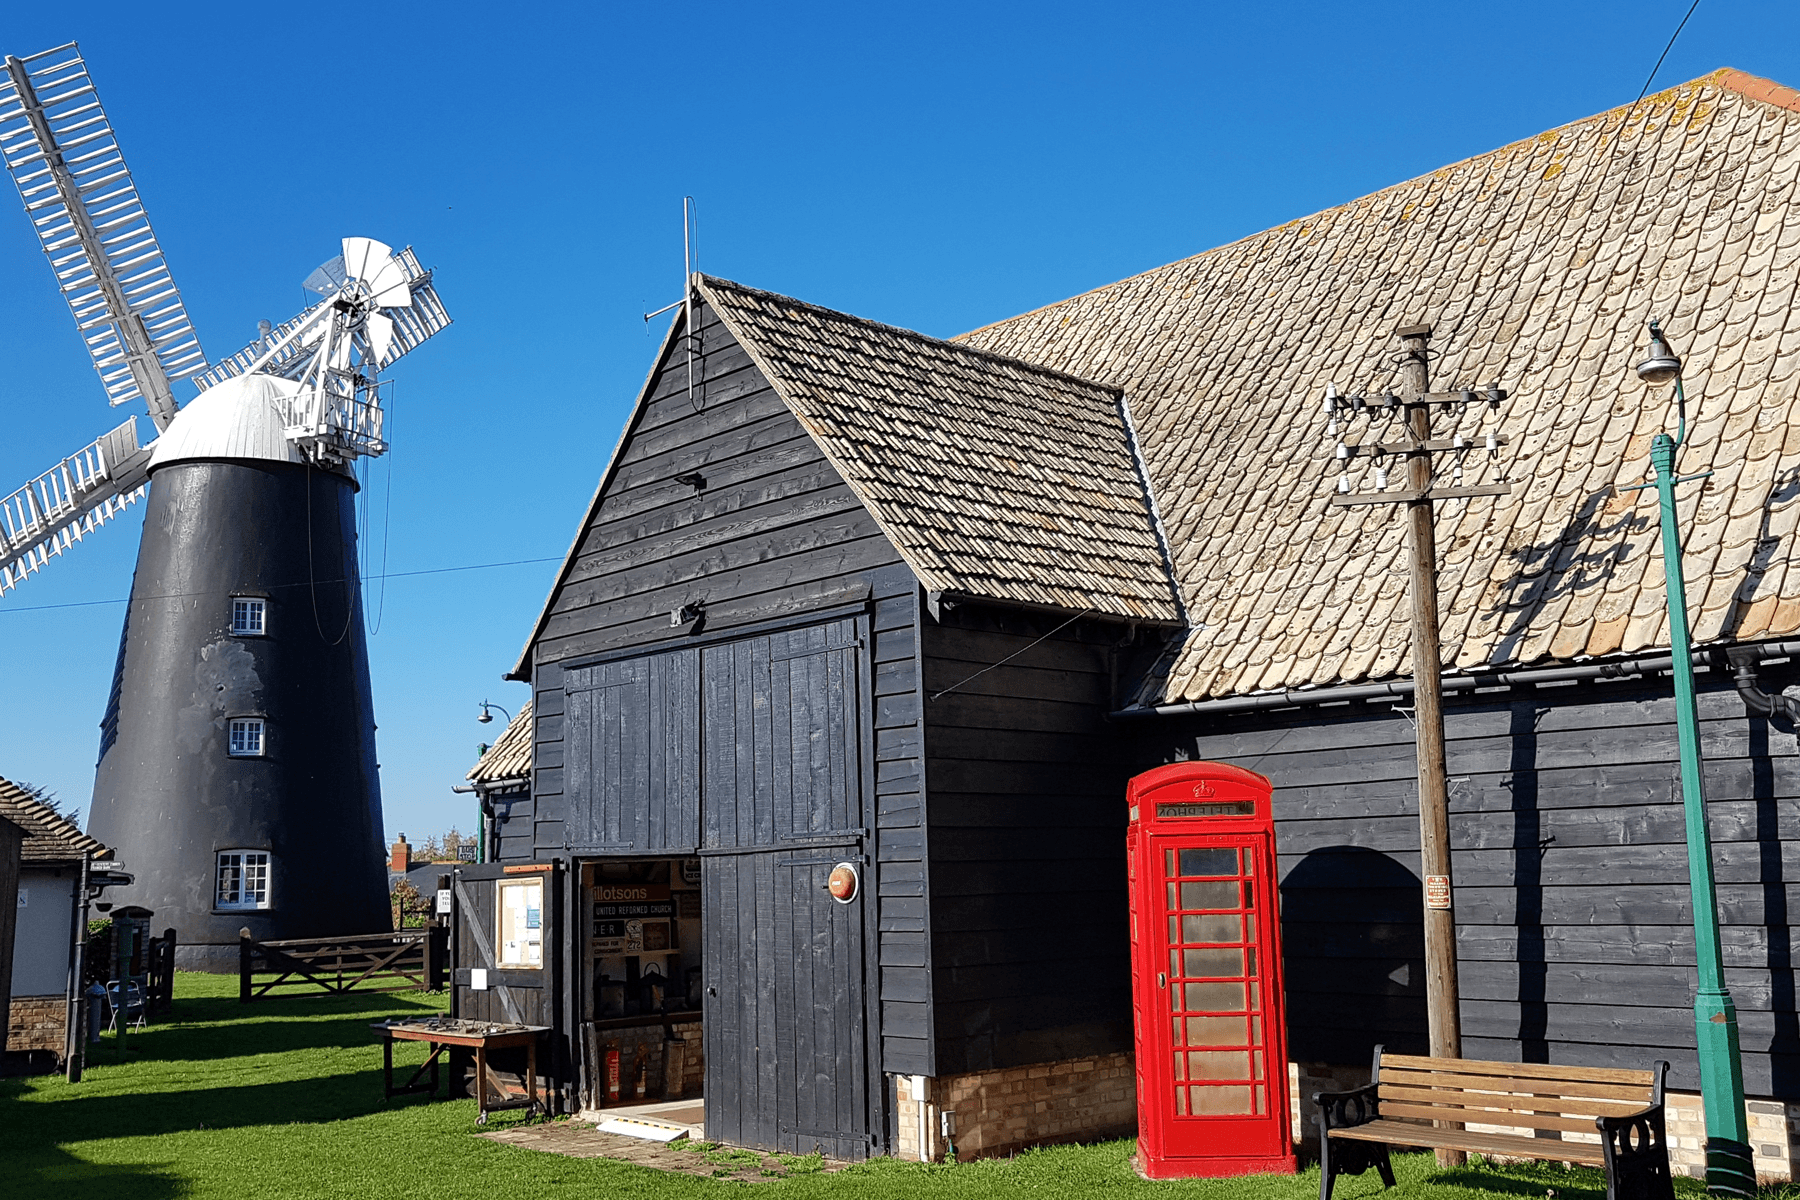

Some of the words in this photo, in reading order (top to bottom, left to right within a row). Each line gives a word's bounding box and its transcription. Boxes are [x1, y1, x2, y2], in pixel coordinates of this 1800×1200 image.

[595, 906, 616, 916] UNITED
[618, 905, 648, 915] REFORMED
[650, 904, 672, 914] CHURCH
[627, 940, 641, 950] 272
